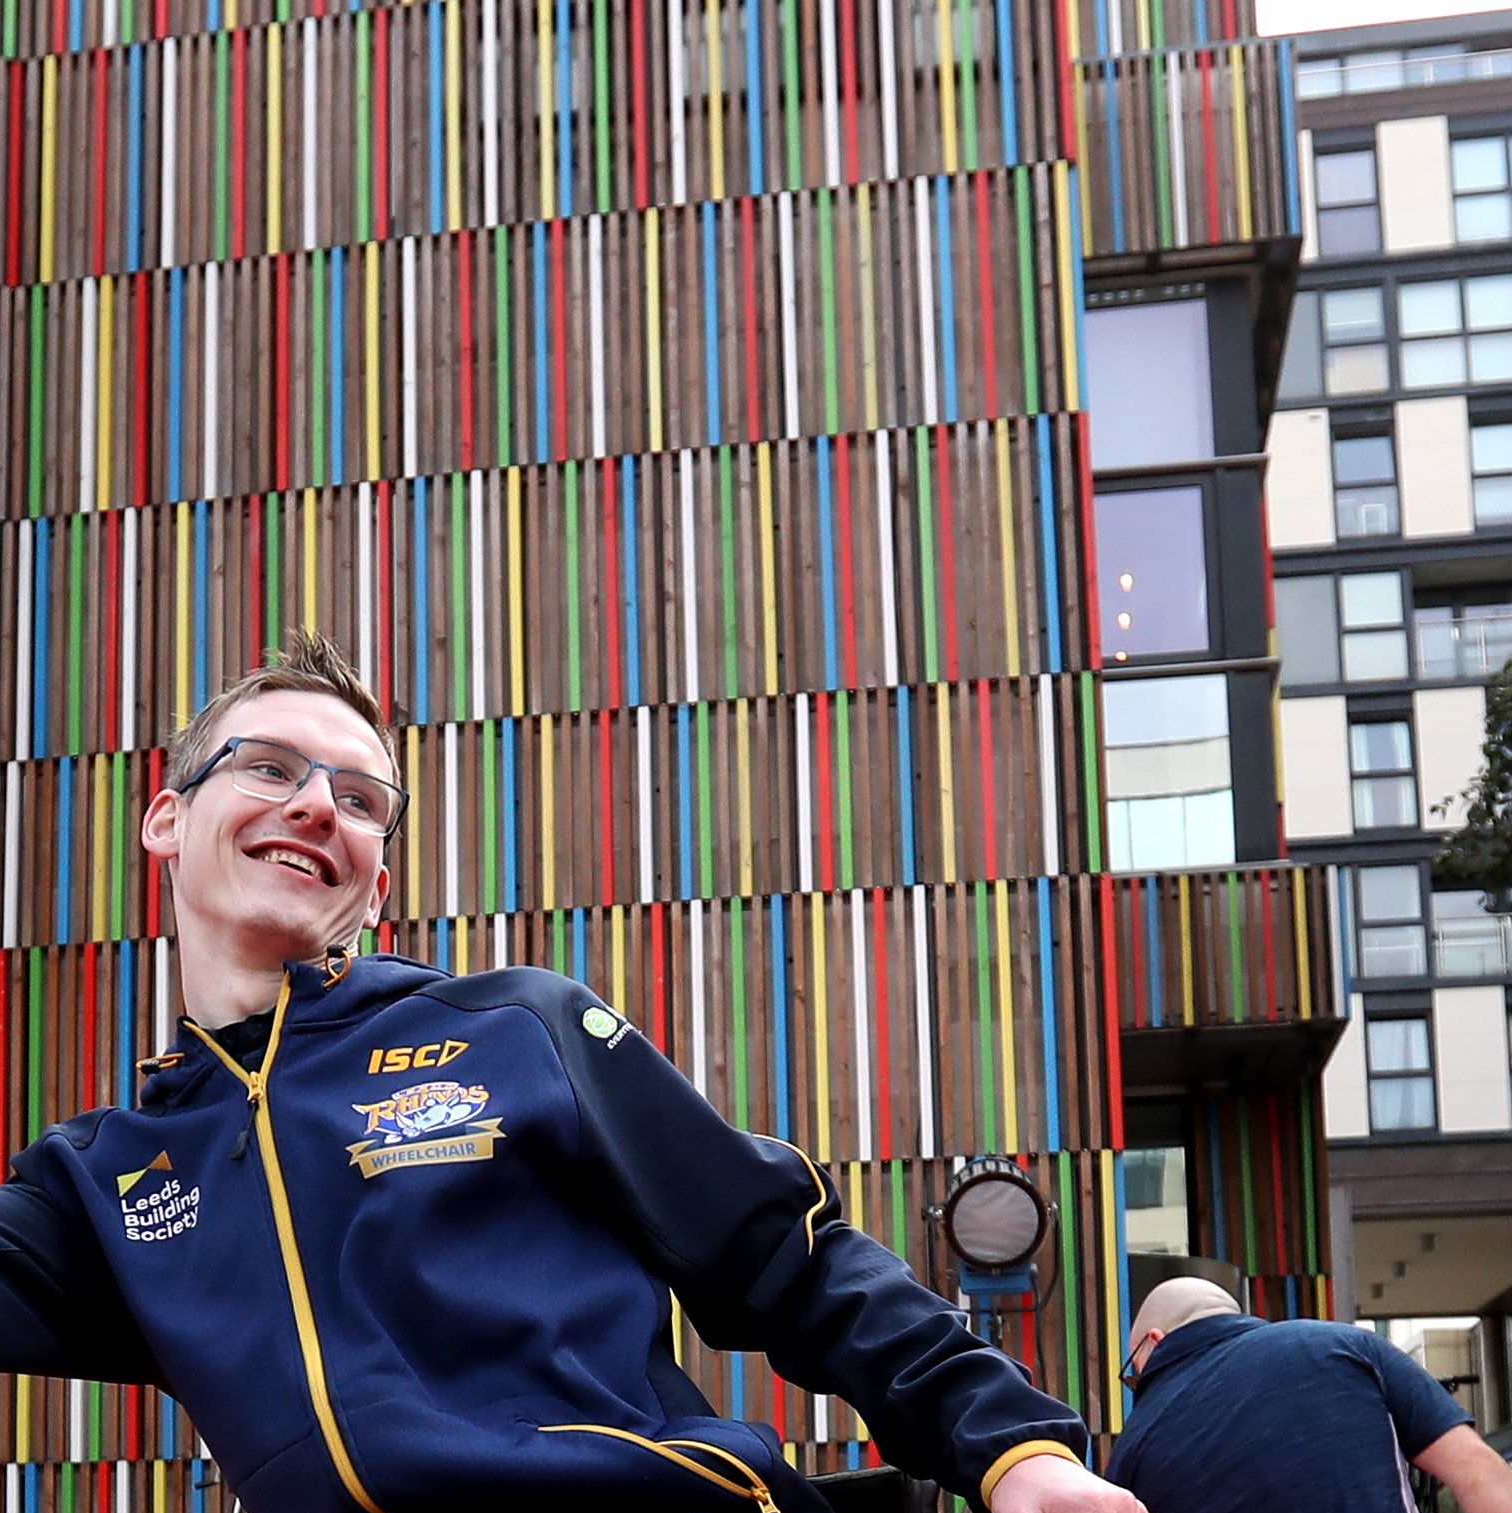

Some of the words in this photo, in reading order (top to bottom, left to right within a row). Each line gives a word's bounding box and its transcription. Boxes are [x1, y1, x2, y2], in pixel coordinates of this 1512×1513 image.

[368, 1044, 441, 1074] ISC
[371, 1142, 477, 1168] WHEELCHAIR
[121, 1179, 181, 1213] Leeds
[124, 1186, 200, 1227] Building
[126, 1206, 199, 1241] Society
